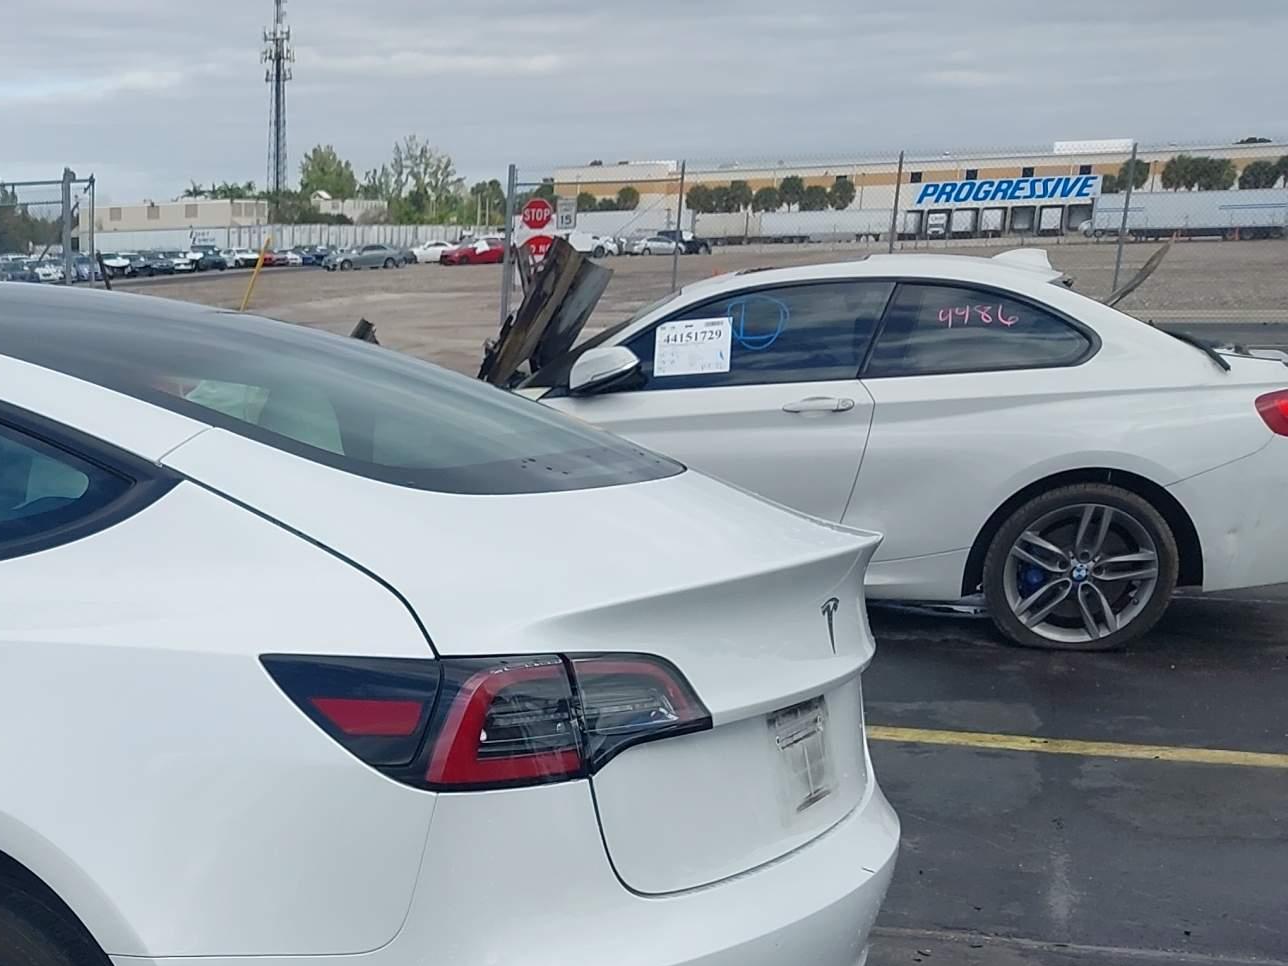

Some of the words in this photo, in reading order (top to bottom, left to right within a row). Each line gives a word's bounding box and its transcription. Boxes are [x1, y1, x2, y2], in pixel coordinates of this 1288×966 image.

[916, 176, 1098, 204] PROGRESSIVE
[524, 208, 550, 221] STOP
[561, 214, 572, 225] 15
[938, 304, 1020, 329] 4486
[663, 329, 722, 344] 44151729
